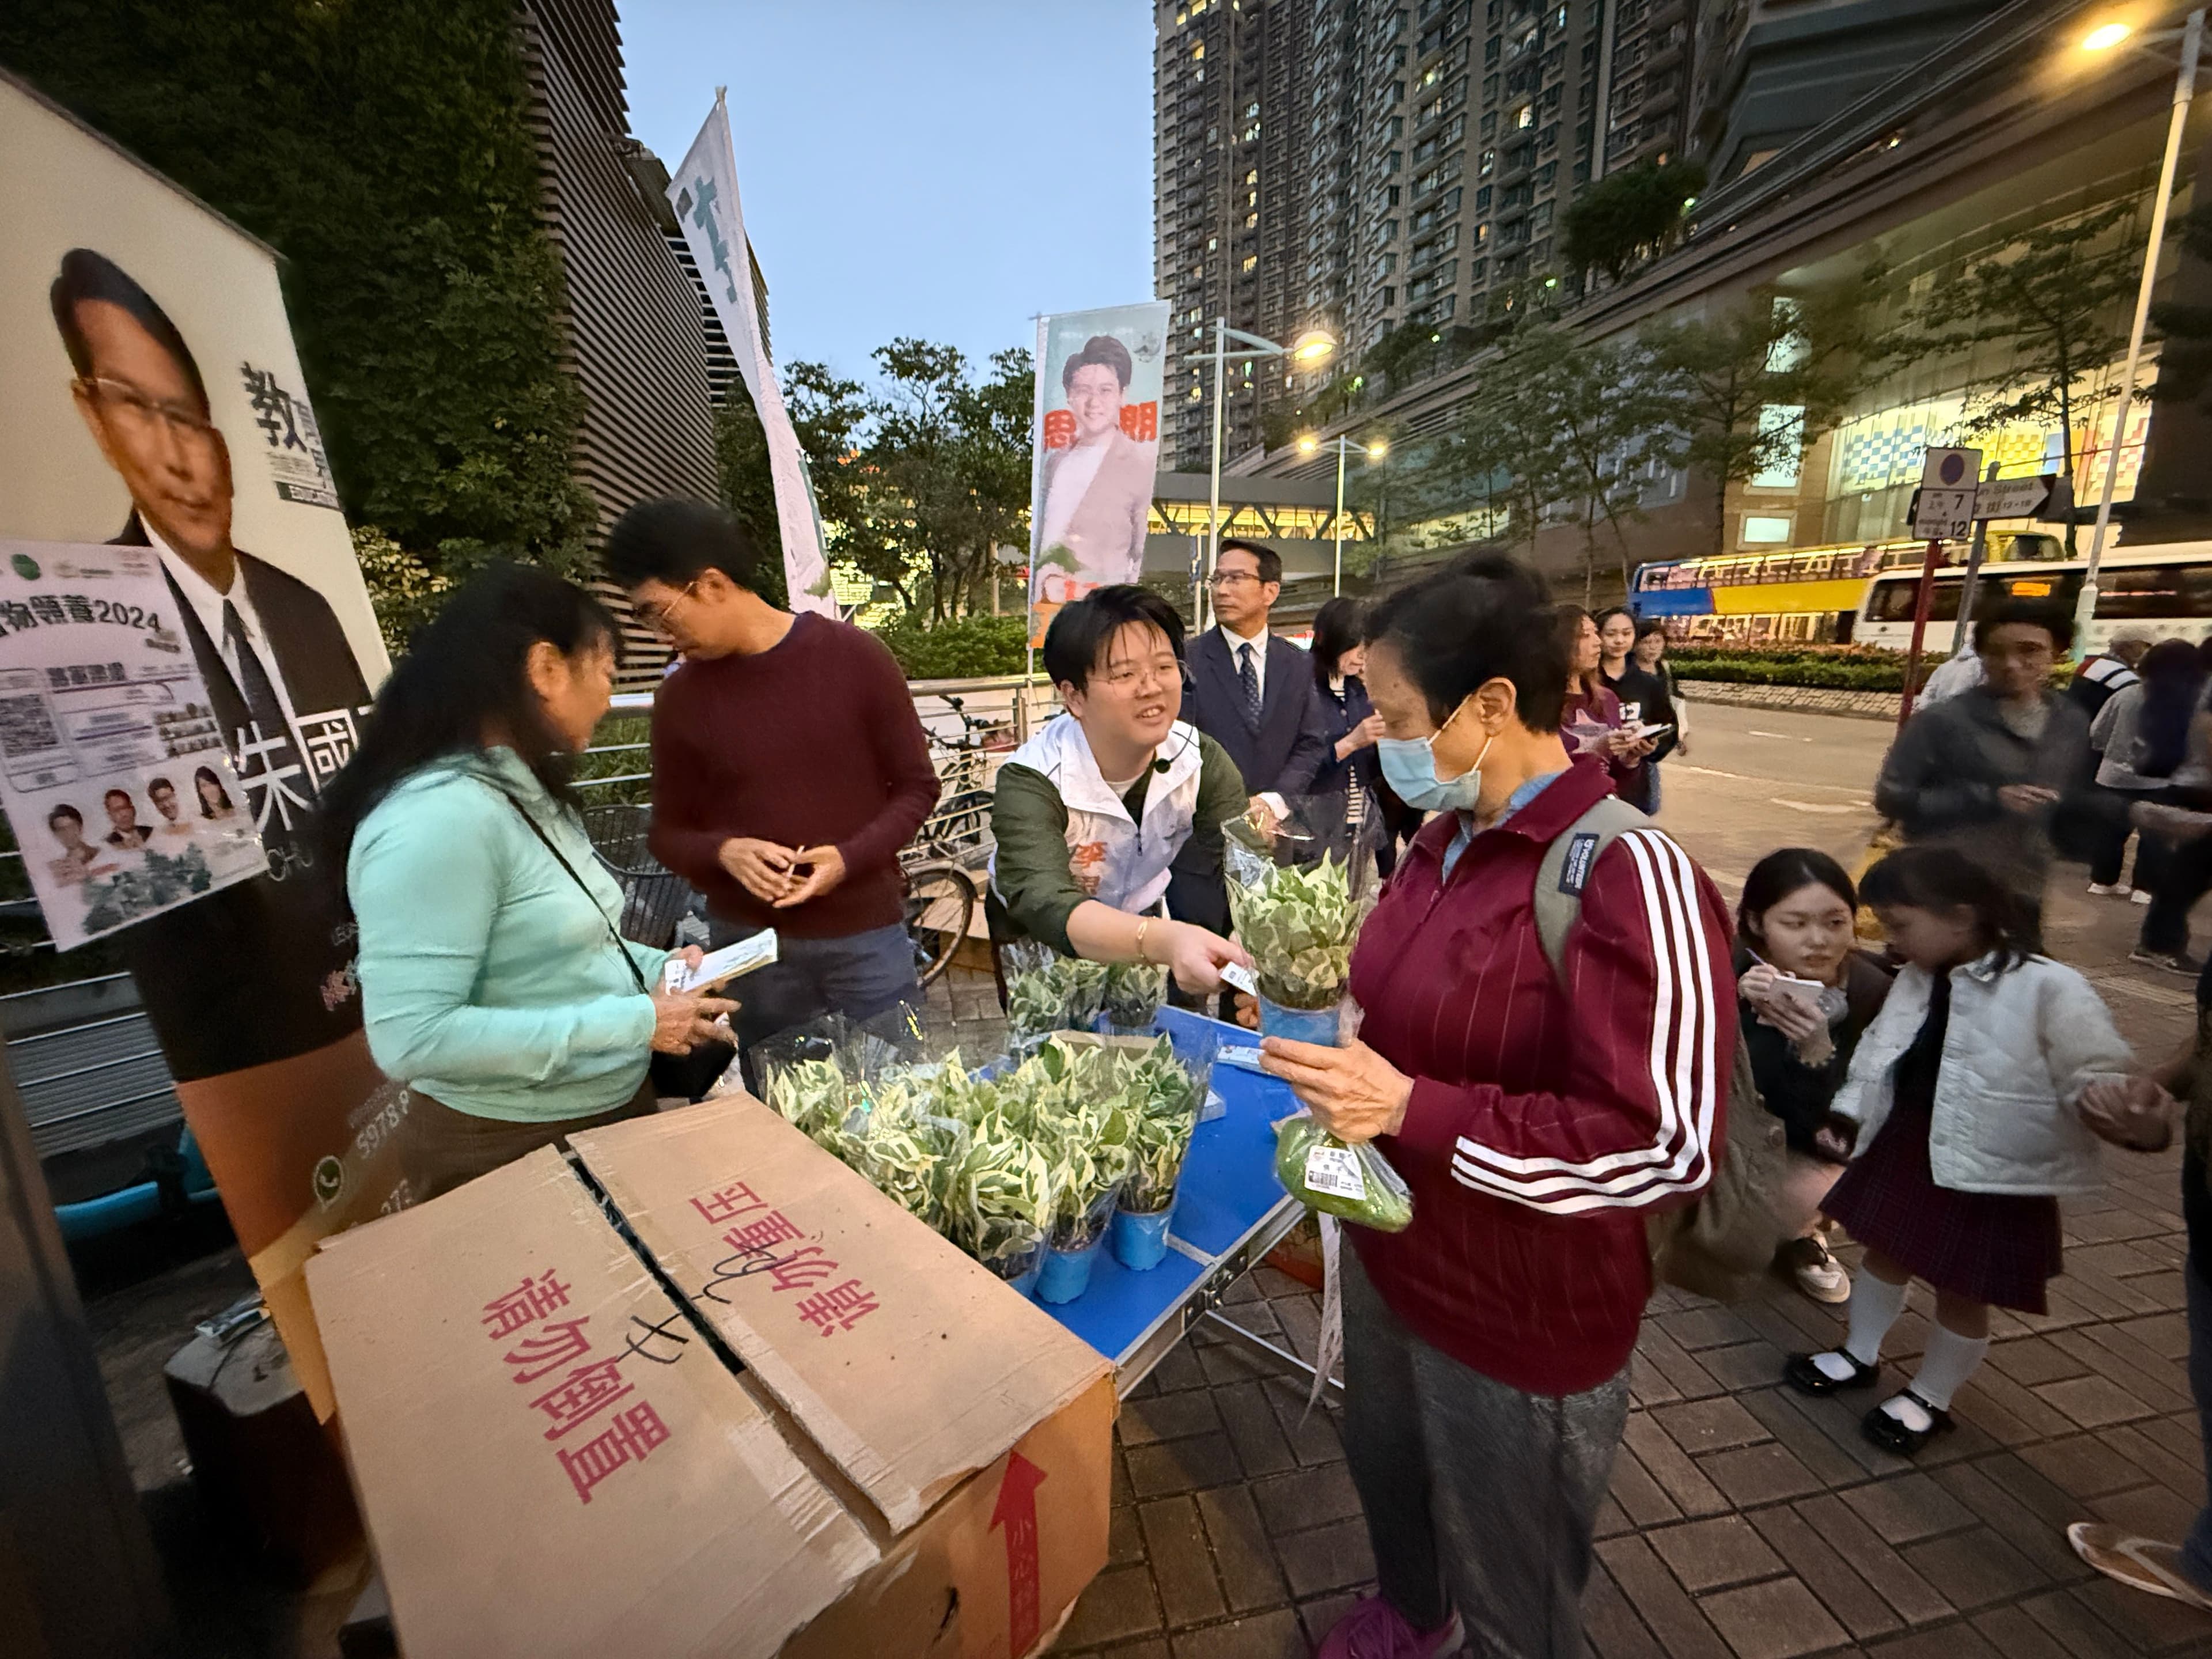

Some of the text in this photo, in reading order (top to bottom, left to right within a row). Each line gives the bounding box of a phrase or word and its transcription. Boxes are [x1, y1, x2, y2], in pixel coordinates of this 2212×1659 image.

[1954, 494, 1964, 510] 7
[1993, 483, 2033, 495] Street
[1950, 520, 1967, 537] 12
[0, 595, 162, 638] 物領養2024
[237, 705, 374, 831] 朱國
[690, 1181, 880, 1337] 请勿重压
[480, 1268, 672, 1505] 请勿倒置
